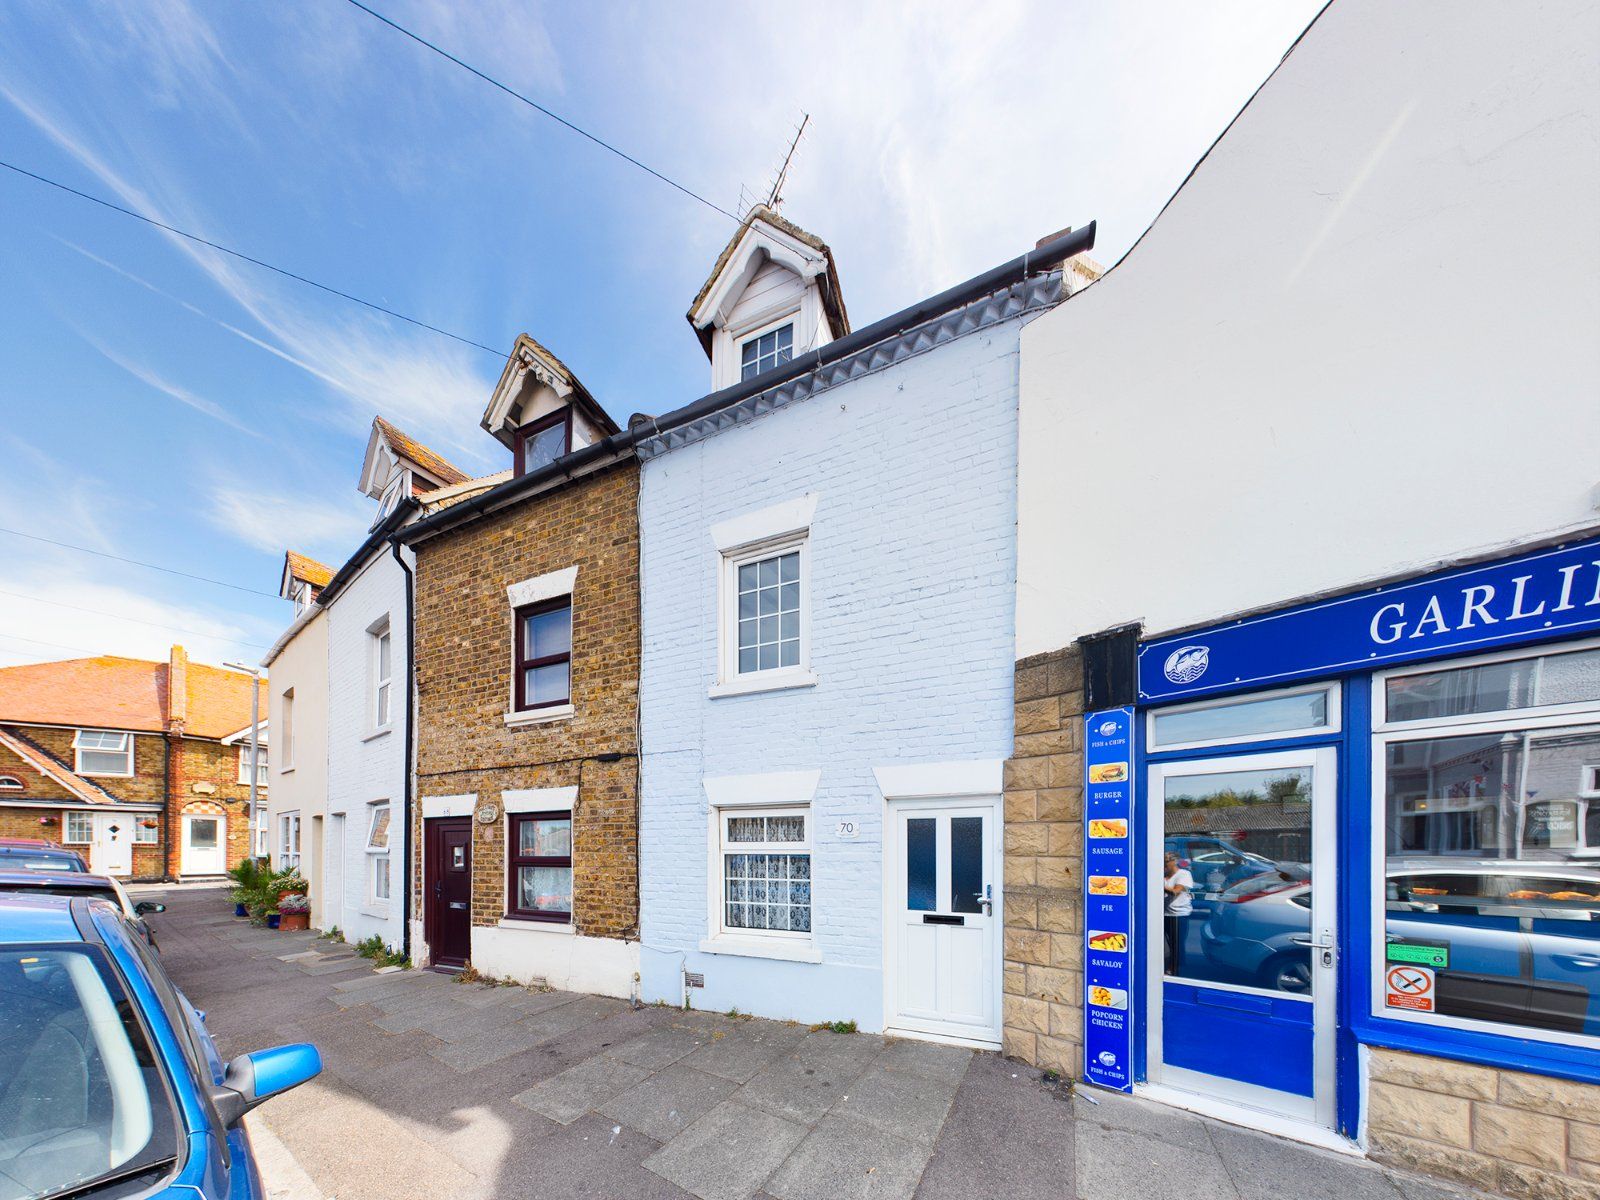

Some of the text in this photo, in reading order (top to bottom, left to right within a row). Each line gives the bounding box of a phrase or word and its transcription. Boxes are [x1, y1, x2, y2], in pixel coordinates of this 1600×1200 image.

[840, 822, 853, 833] 70
[1092, 959, 1123, 969] SAVALOY
[1091, 1010, 1123, 1022] POPCORN
[1092, 1018, 1123, 1030] CHICKEN
[1108, 1071, 1125, 1080] CHIPS
